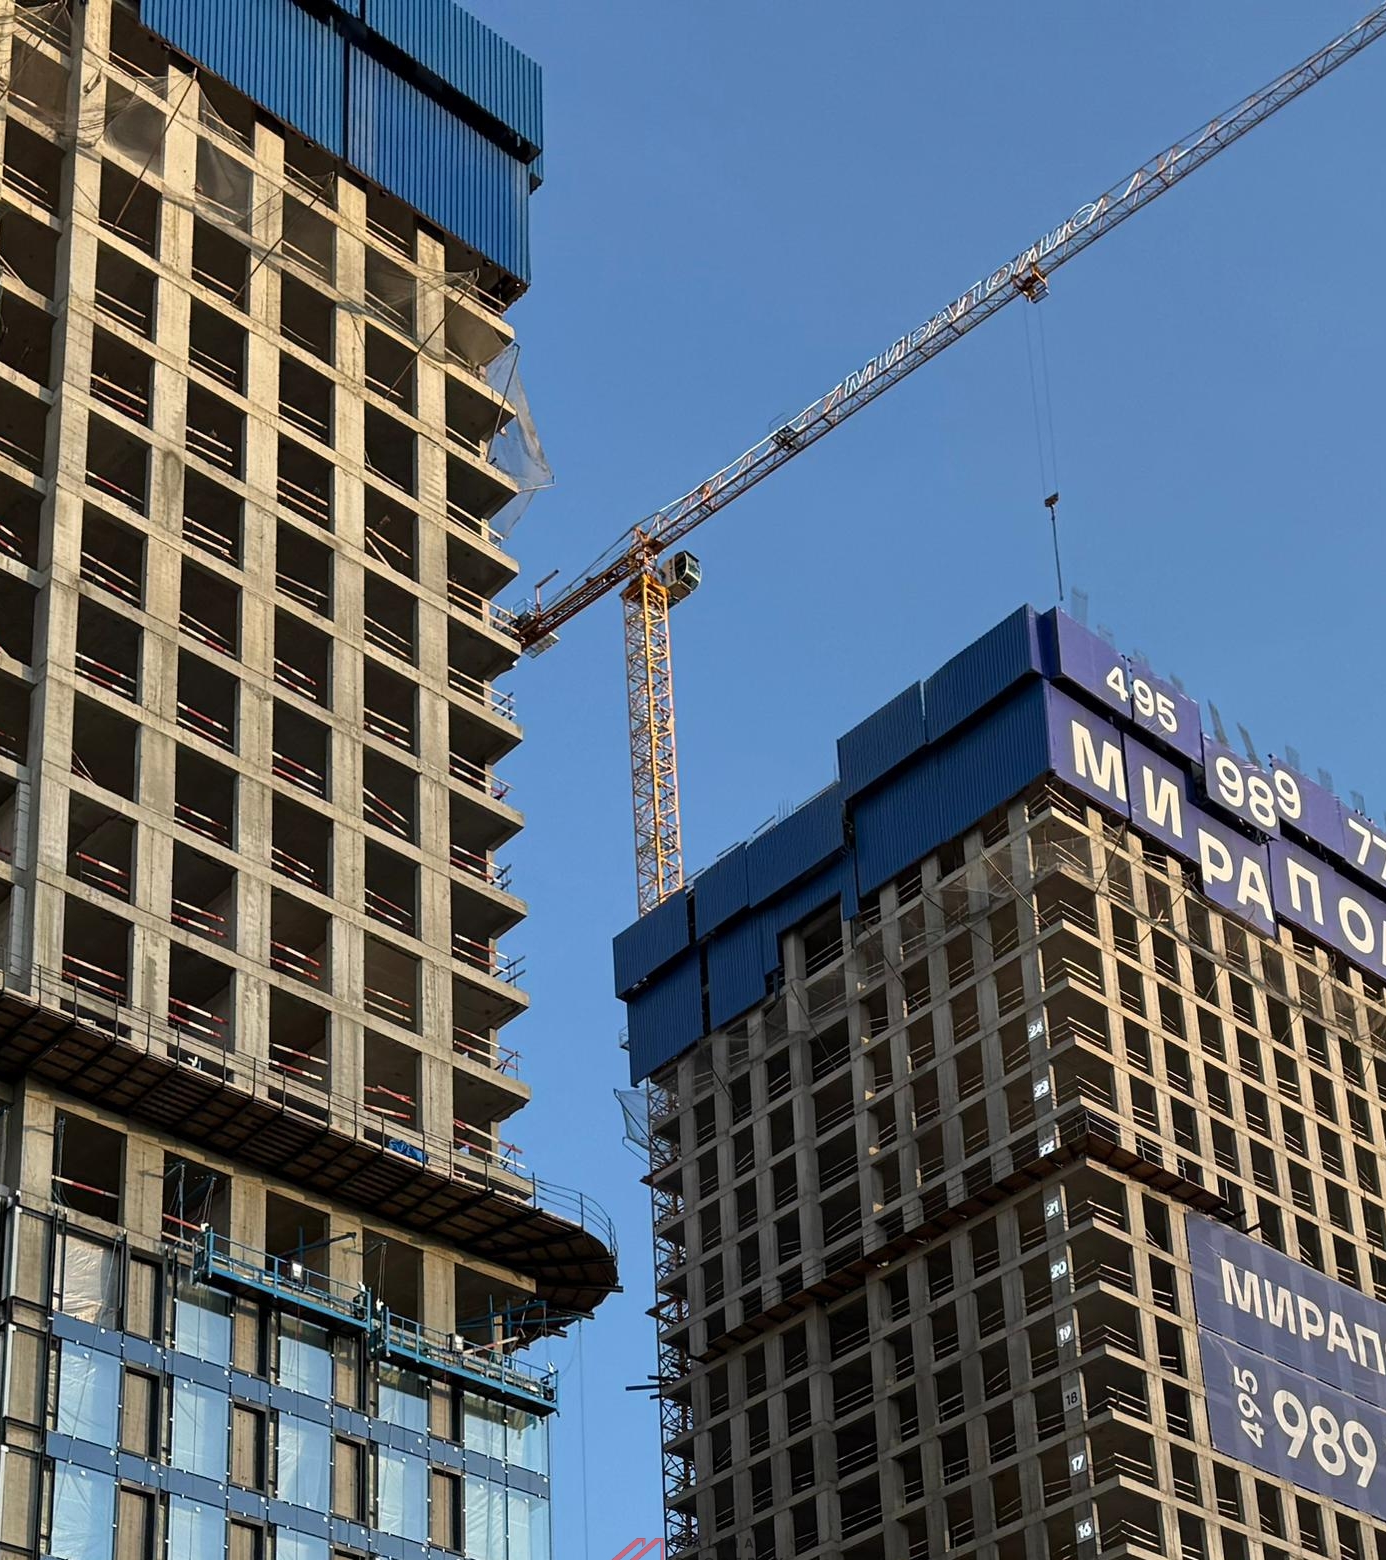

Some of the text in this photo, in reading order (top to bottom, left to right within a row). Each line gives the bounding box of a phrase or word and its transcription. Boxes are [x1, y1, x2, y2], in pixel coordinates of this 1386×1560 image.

[1106, 666, 1178, 732] 495
[1215, 756, 1301, 828] 989
[1051, 1261, 1067, 1279] 20
[1066, 1391, 1078, 1405] 18
[1234, 1366, 1265, 1448] 495
[1273, 1389, 1377, 1488] 989
[1072, 1455, 1083, 1471] 17
[1078, 1522, 1091, 1539] 16
